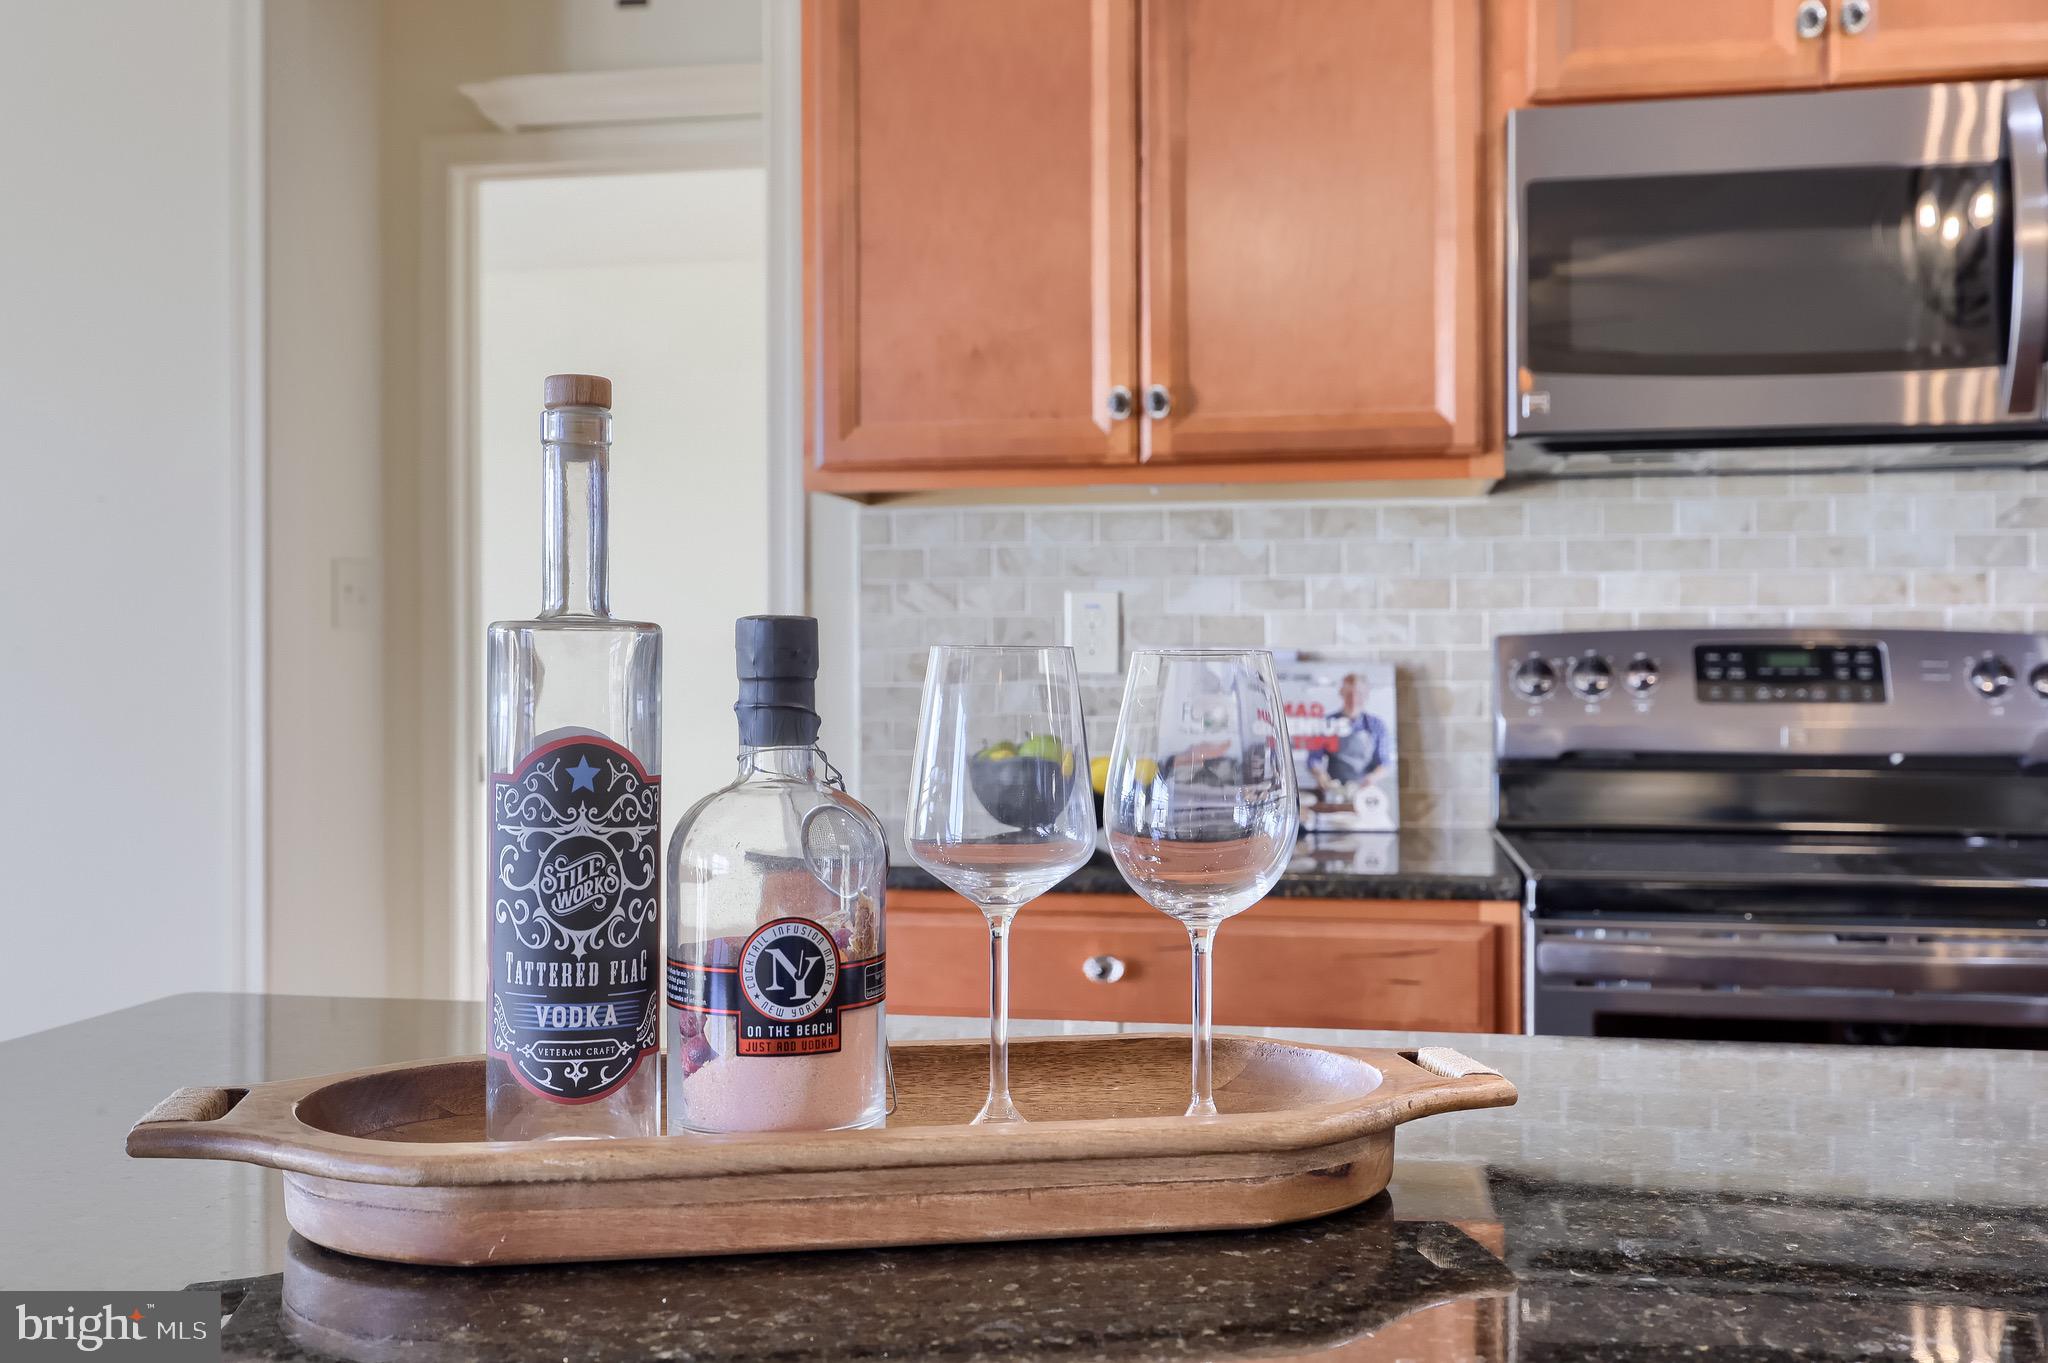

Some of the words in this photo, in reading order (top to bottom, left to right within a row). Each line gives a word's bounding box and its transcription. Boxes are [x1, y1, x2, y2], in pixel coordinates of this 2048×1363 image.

[541, 859, 600, 894] STILL
[555, 864, 620, 910] WORKS
[505, 951, 600, 987] TATTERED
[609, 949, 647, 985] FLAG
[744, 936, 769, 990] COCKTAIL
[772, 924, 825, 946] INFUSION
[822, 948, 834, 986] MIXER
[764, 948, 822, 1001] NY
[534, 1004, 619, 1029] VODKA
[760, 1001, 785, 1018] NEW
[791, 999, 820, 1018] YORK
[747, 1025, 762, 1038] ON
[768, 1024, 790, 1037] THE
[796, 1022, 833, 1036] BEACH
[538, 1047, 582, 1057] VETERAN
[586, 1045, 616, 1056] CRAFT
[745, 1041, 772, 1053] JUST
[776, 1040, 797, 1052] ADD
[801, 1038, 834, 1051] VODKA
